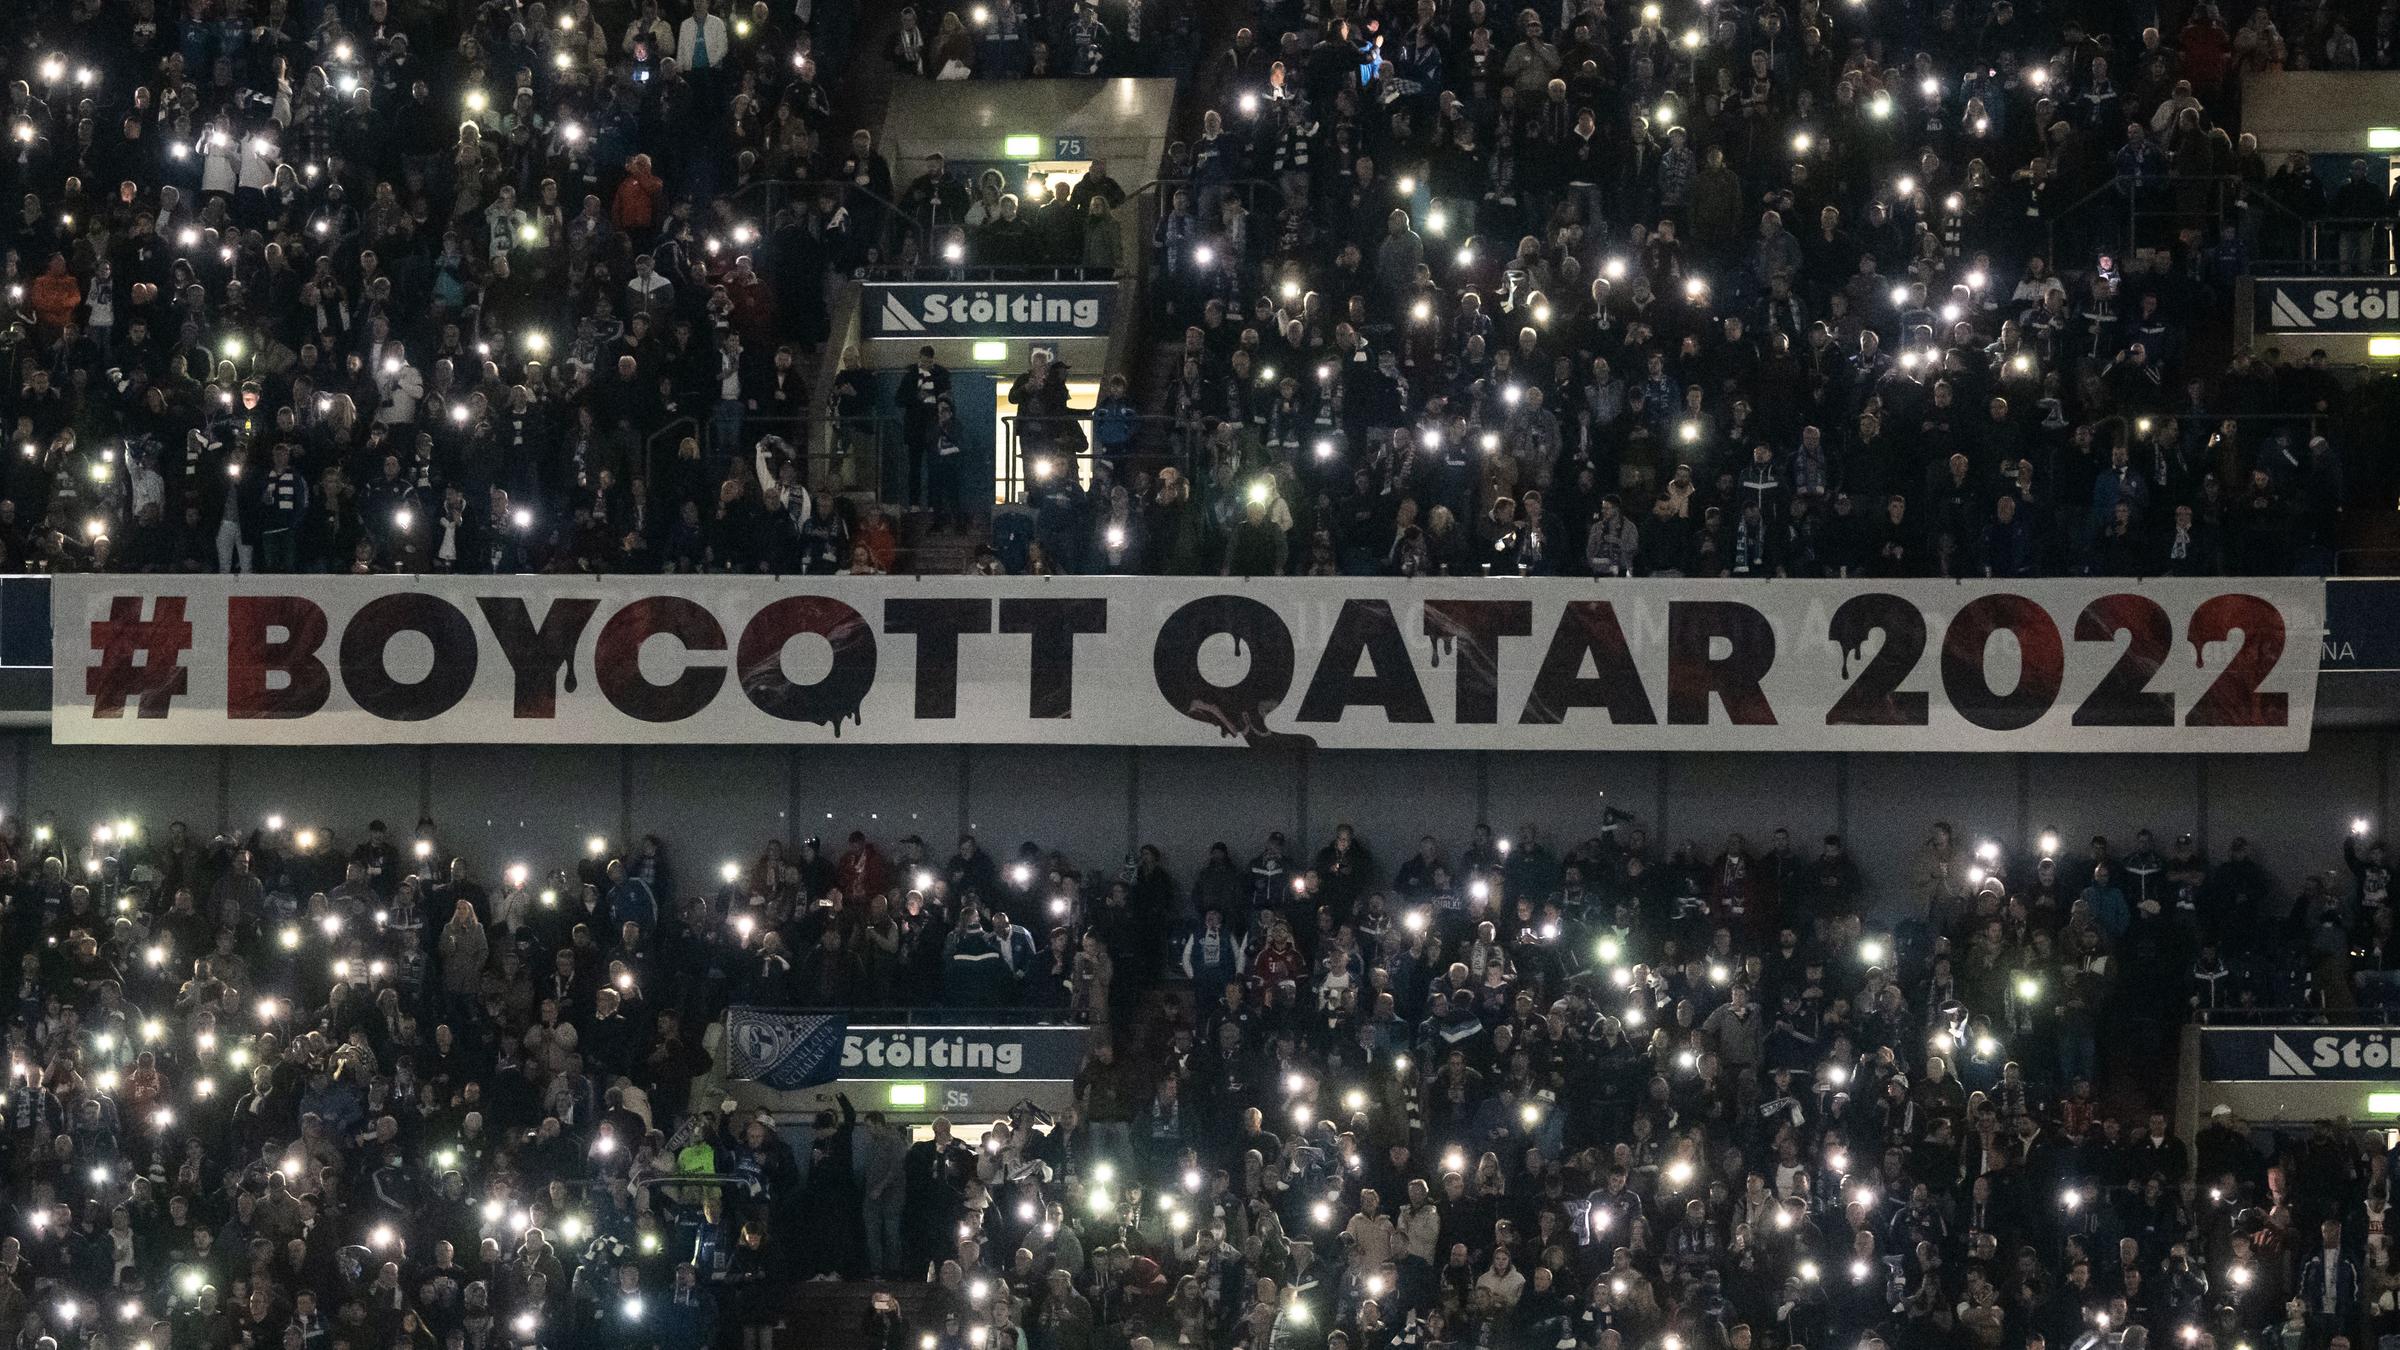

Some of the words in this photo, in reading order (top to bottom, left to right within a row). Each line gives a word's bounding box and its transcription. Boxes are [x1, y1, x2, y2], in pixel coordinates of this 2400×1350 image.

[1058, 139, 1081, 155] 75
[923, 291, 1099, 328] Stölting
[2312, 287, 2400, 319] Stöl
[1153, 595, 1778, 746] QATAR
[1826, 592, 2289, 732] 2022
[841, 1034, 1022, 1074] Stölting
[948, 1090, 968, 1107] S5
